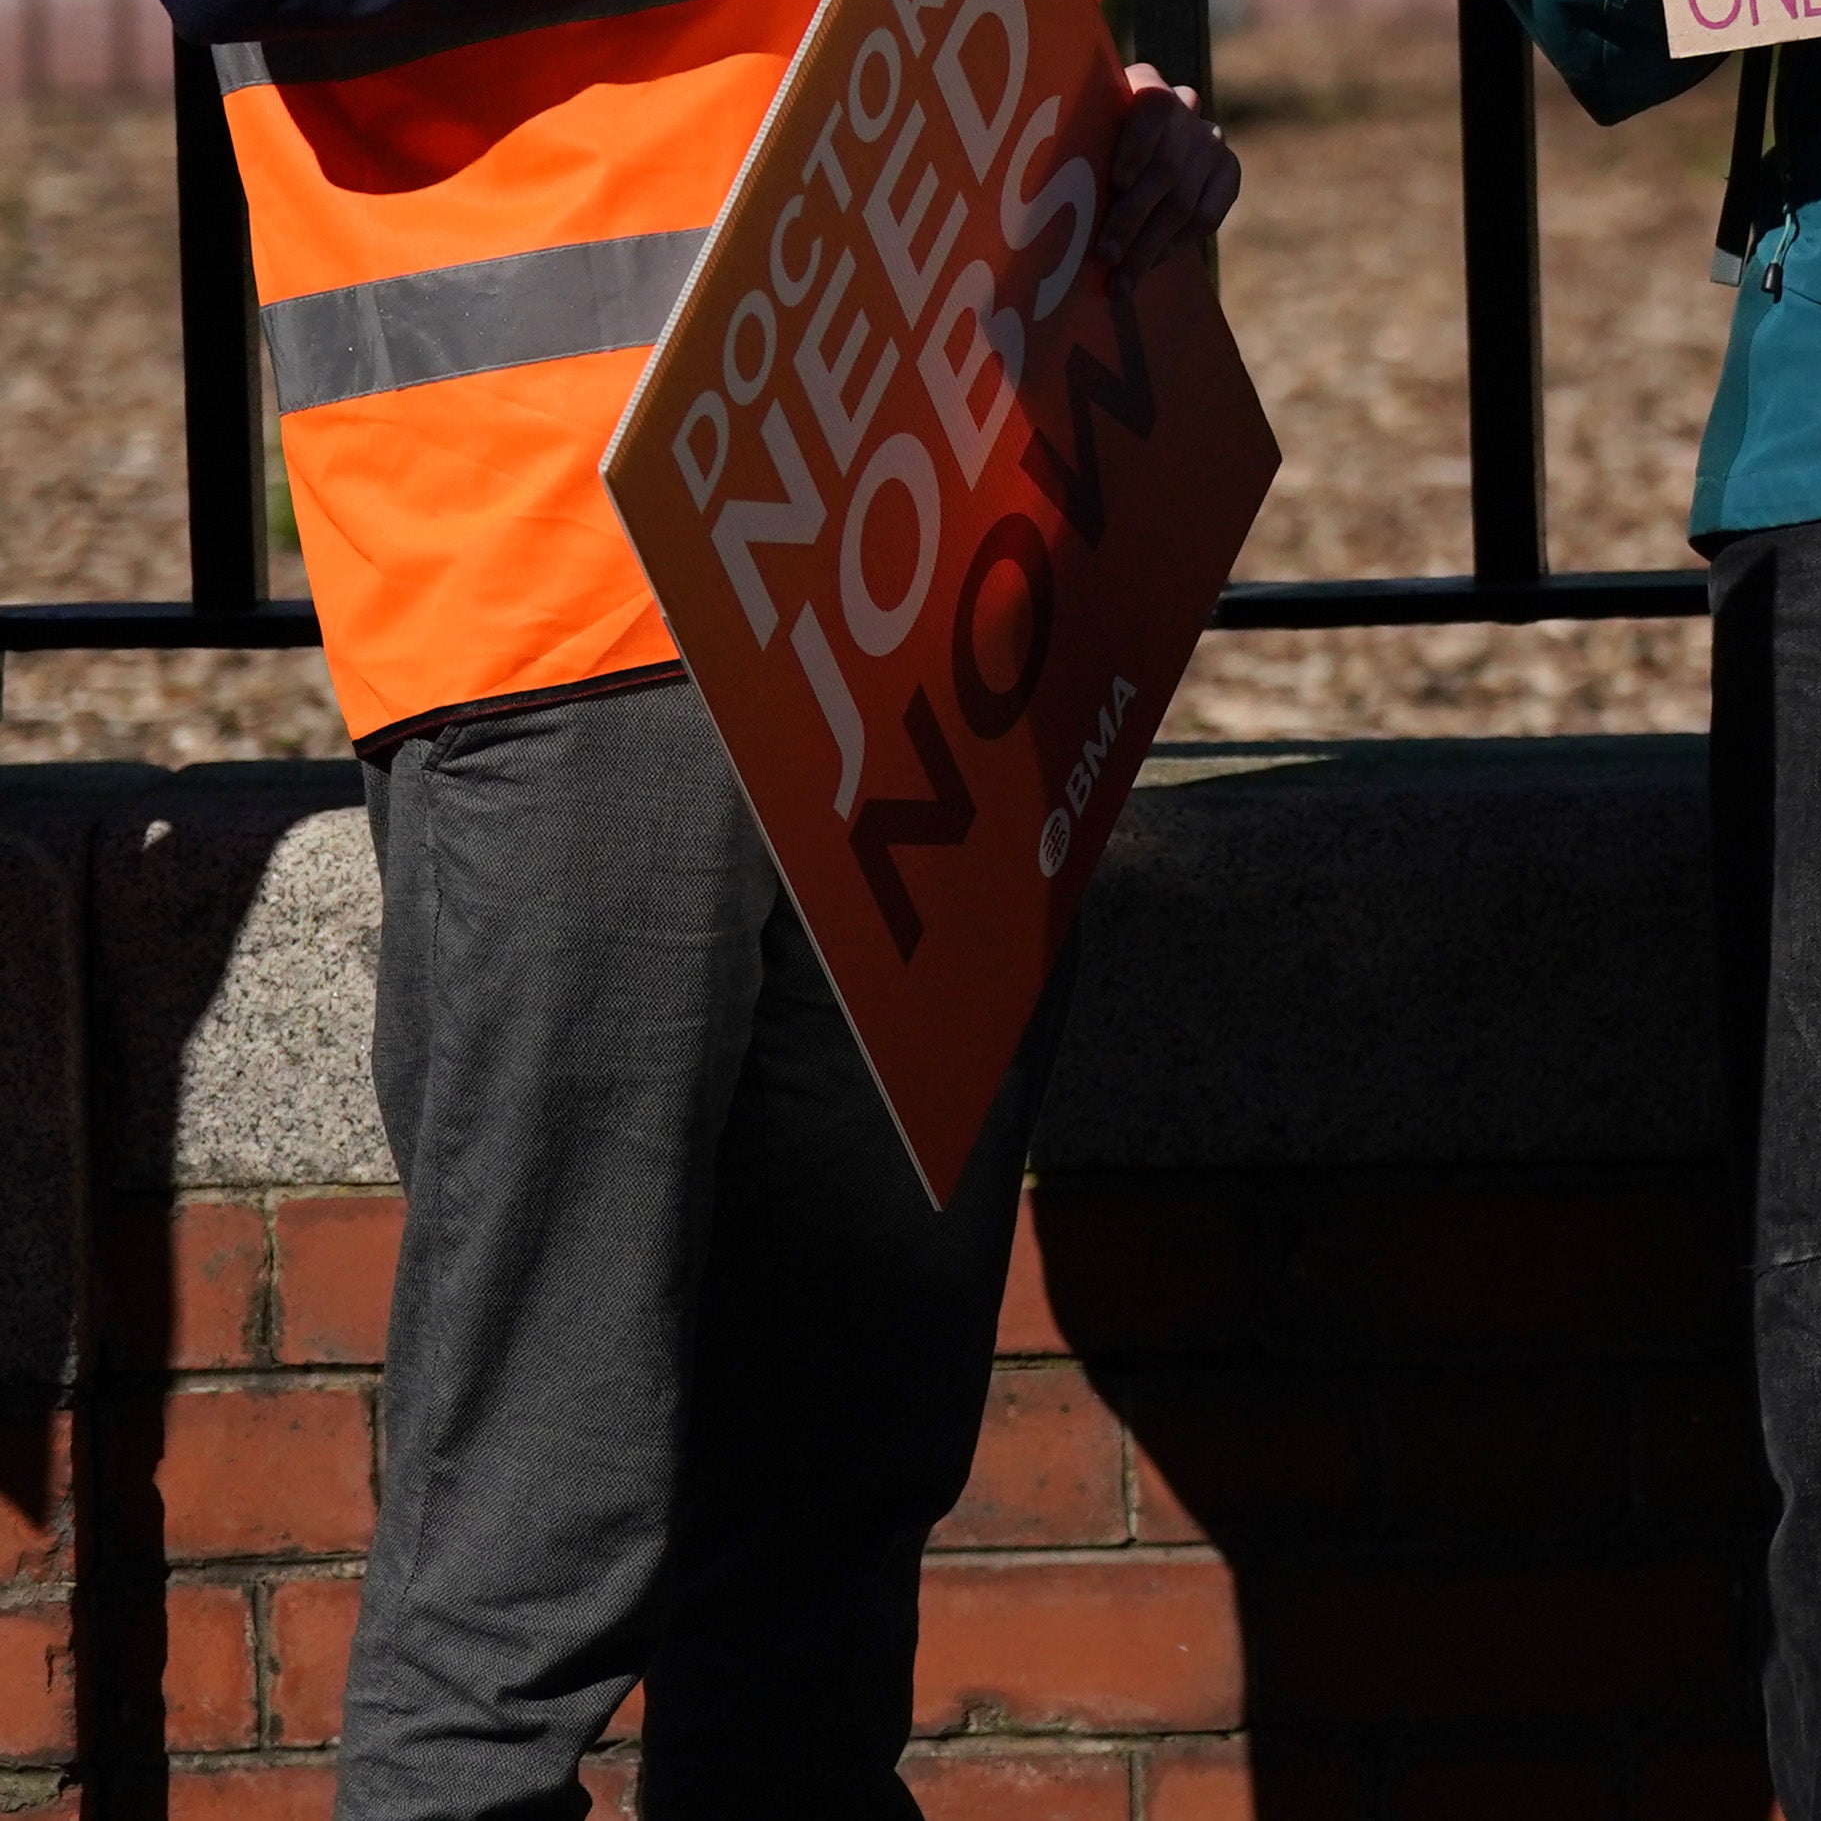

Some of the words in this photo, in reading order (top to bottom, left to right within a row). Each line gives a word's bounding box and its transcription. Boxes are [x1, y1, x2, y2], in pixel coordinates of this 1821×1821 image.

[789, 94, 1097, 822] JOBS
[848, 282, 1158, 967] NOW
[1065, 675, 1139, 819] BMA
